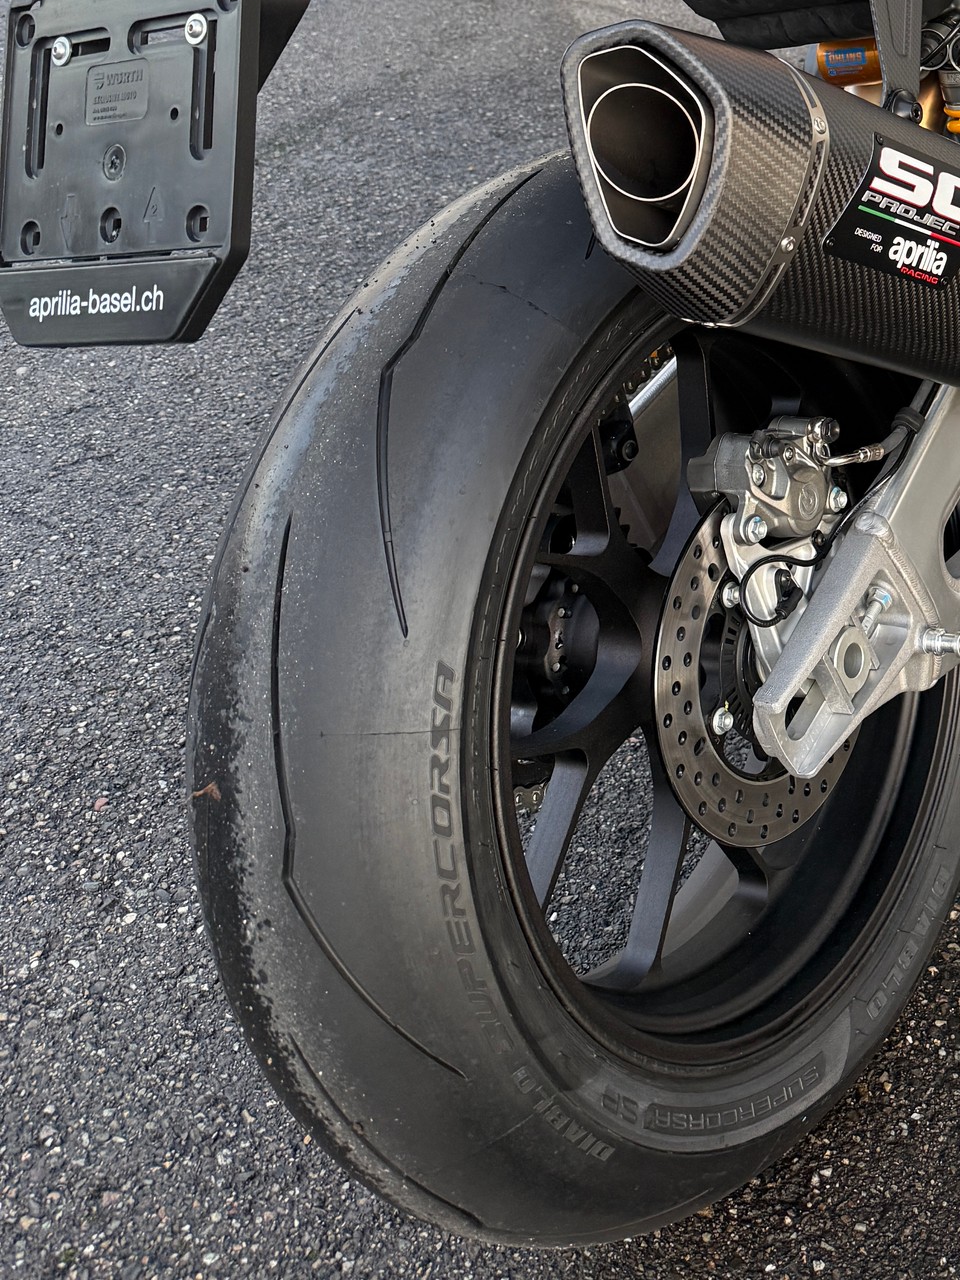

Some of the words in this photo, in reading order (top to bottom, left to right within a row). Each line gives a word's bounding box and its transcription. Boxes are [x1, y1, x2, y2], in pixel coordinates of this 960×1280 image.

[854, 227, 882, 242] DESIGNED
[870, 243, 884, 254] FOR
[888, 236, 948, 276] aprilia
[900, 266, 939, 285] RACING
[29, 284, 164, 322] aprilia-basel.ch
[655, 1066, 819, 1131] SUPERCORSA
[518, 1077, 616, 1162] DIABLO
